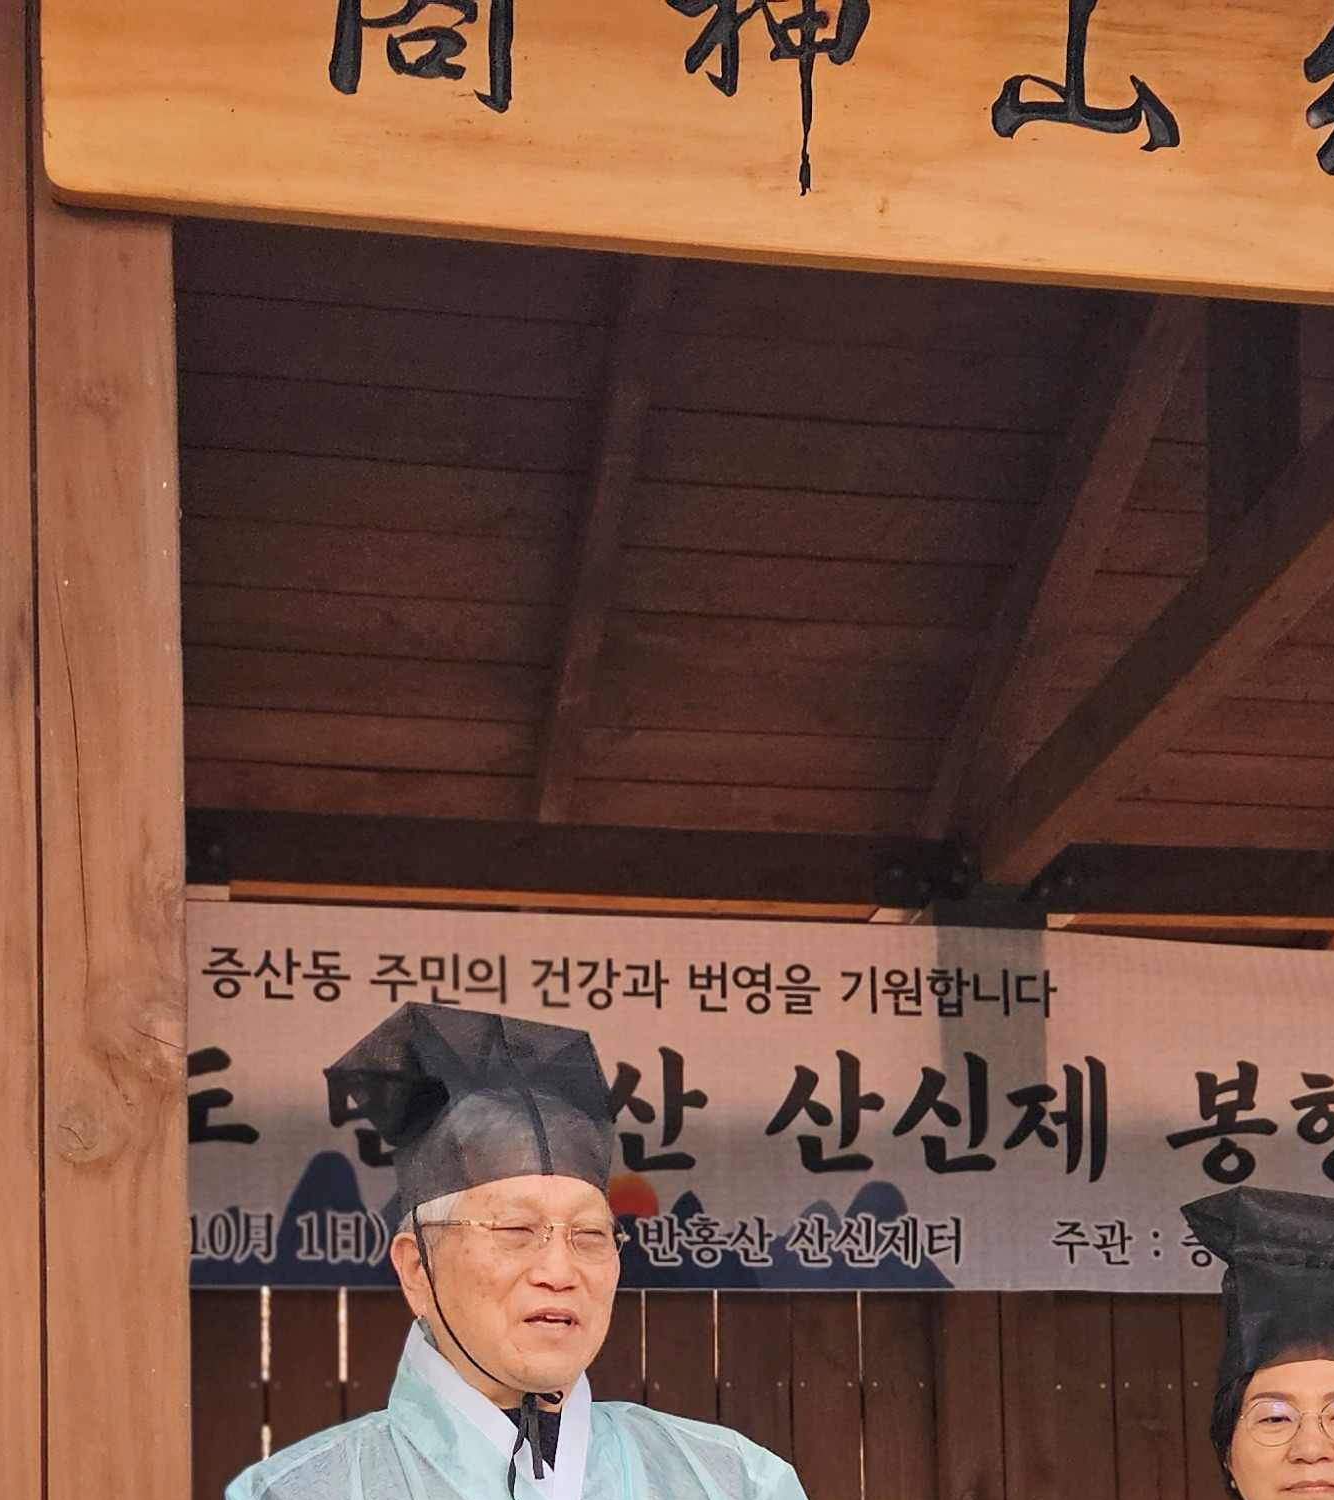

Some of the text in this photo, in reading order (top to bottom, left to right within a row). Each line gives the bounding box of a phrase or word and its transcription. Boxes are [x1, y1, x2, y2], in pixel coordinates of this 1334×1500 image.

[201, 946, 1058, 1019] 증산동 주민의 건강과 번영을 기원합니다
[764, 1049, 1108, 1183] 산신제
[639, 1214, 962, 1266] 반홍산 산신제터
[1051, 1219, 1133, 1266] 주관
